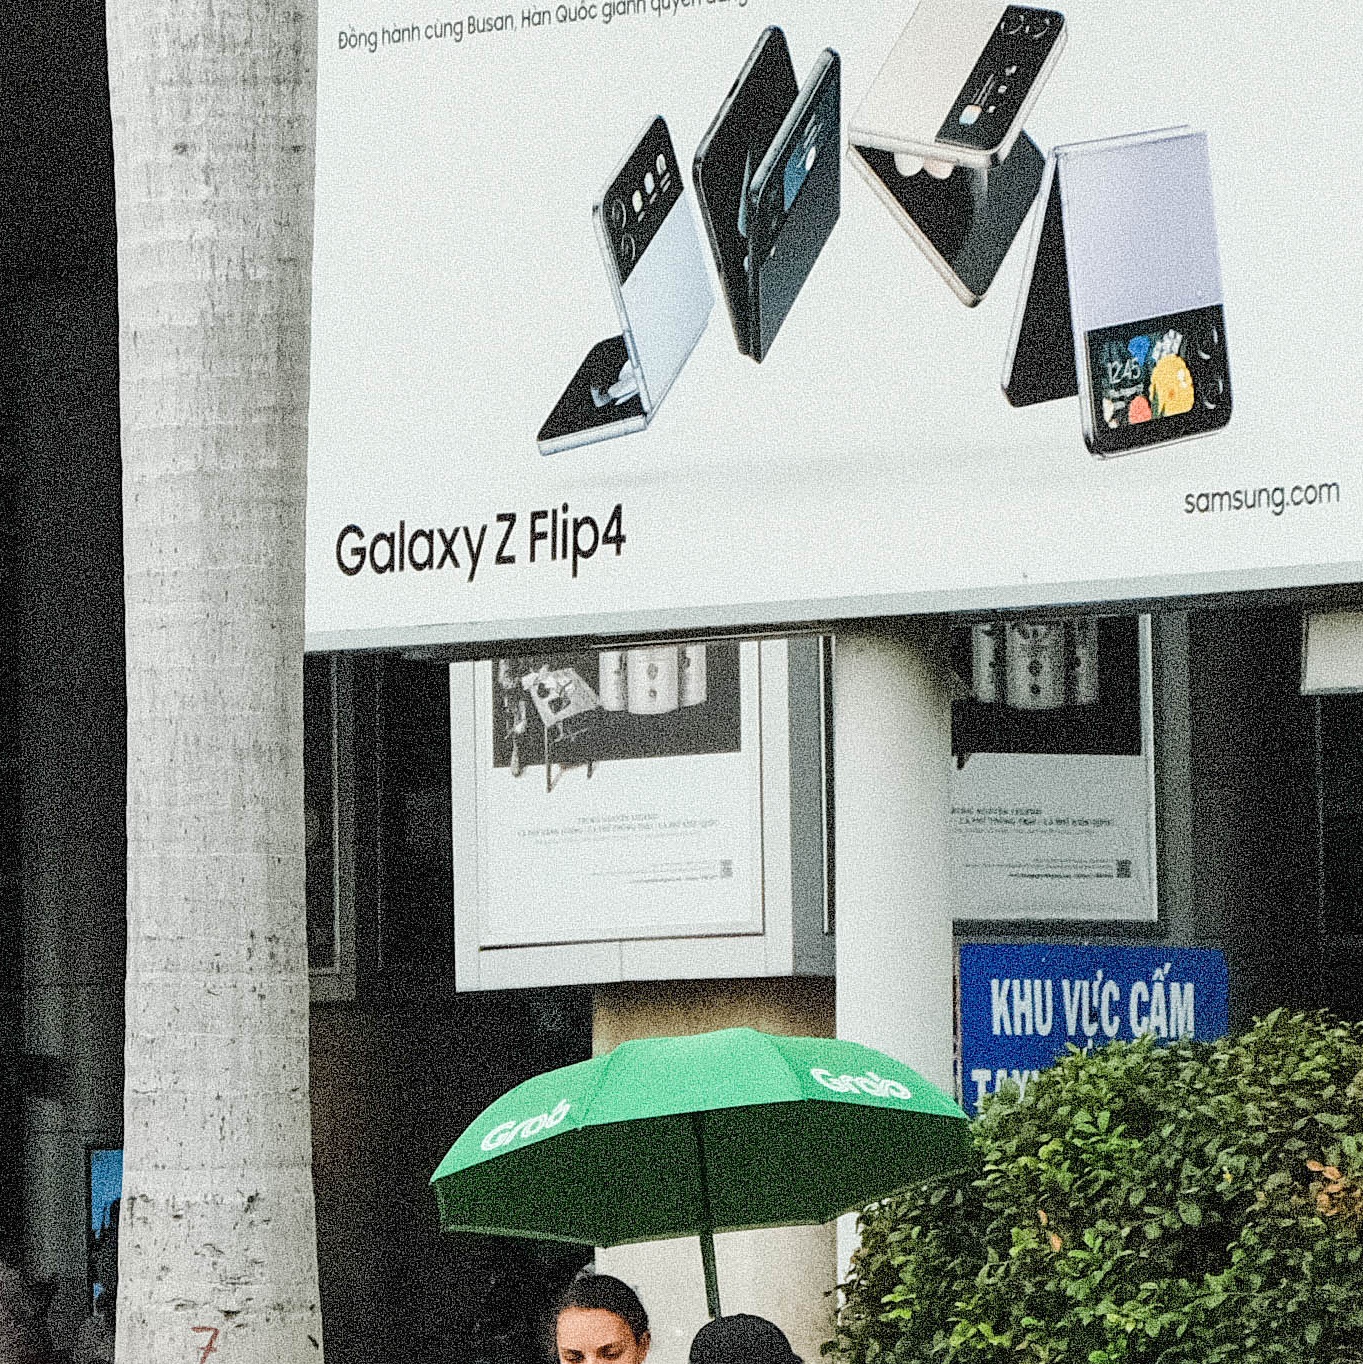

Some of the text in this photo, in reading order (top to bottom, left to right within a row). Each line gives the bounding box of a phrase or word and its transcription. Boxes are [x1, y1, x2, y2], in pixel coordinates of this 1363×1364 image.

[339, 23, 377, 52] Đồng
[382, 23, 420, 46] hành
[424, 18, 463, 43] cùng
[467, 14, 517, 34] Busan,
[521, 4, 552, 28] Hàn
[1184, 482, 1340, 516] samsung.com
[336, 502, 626, 582] Galaxy Z Flip4
[991, 962, 1195, 1050] KHU VỰC CẤM
[810, 1067, 911, 1101] Grab
[481, 1097, 571, 1152] Grab
